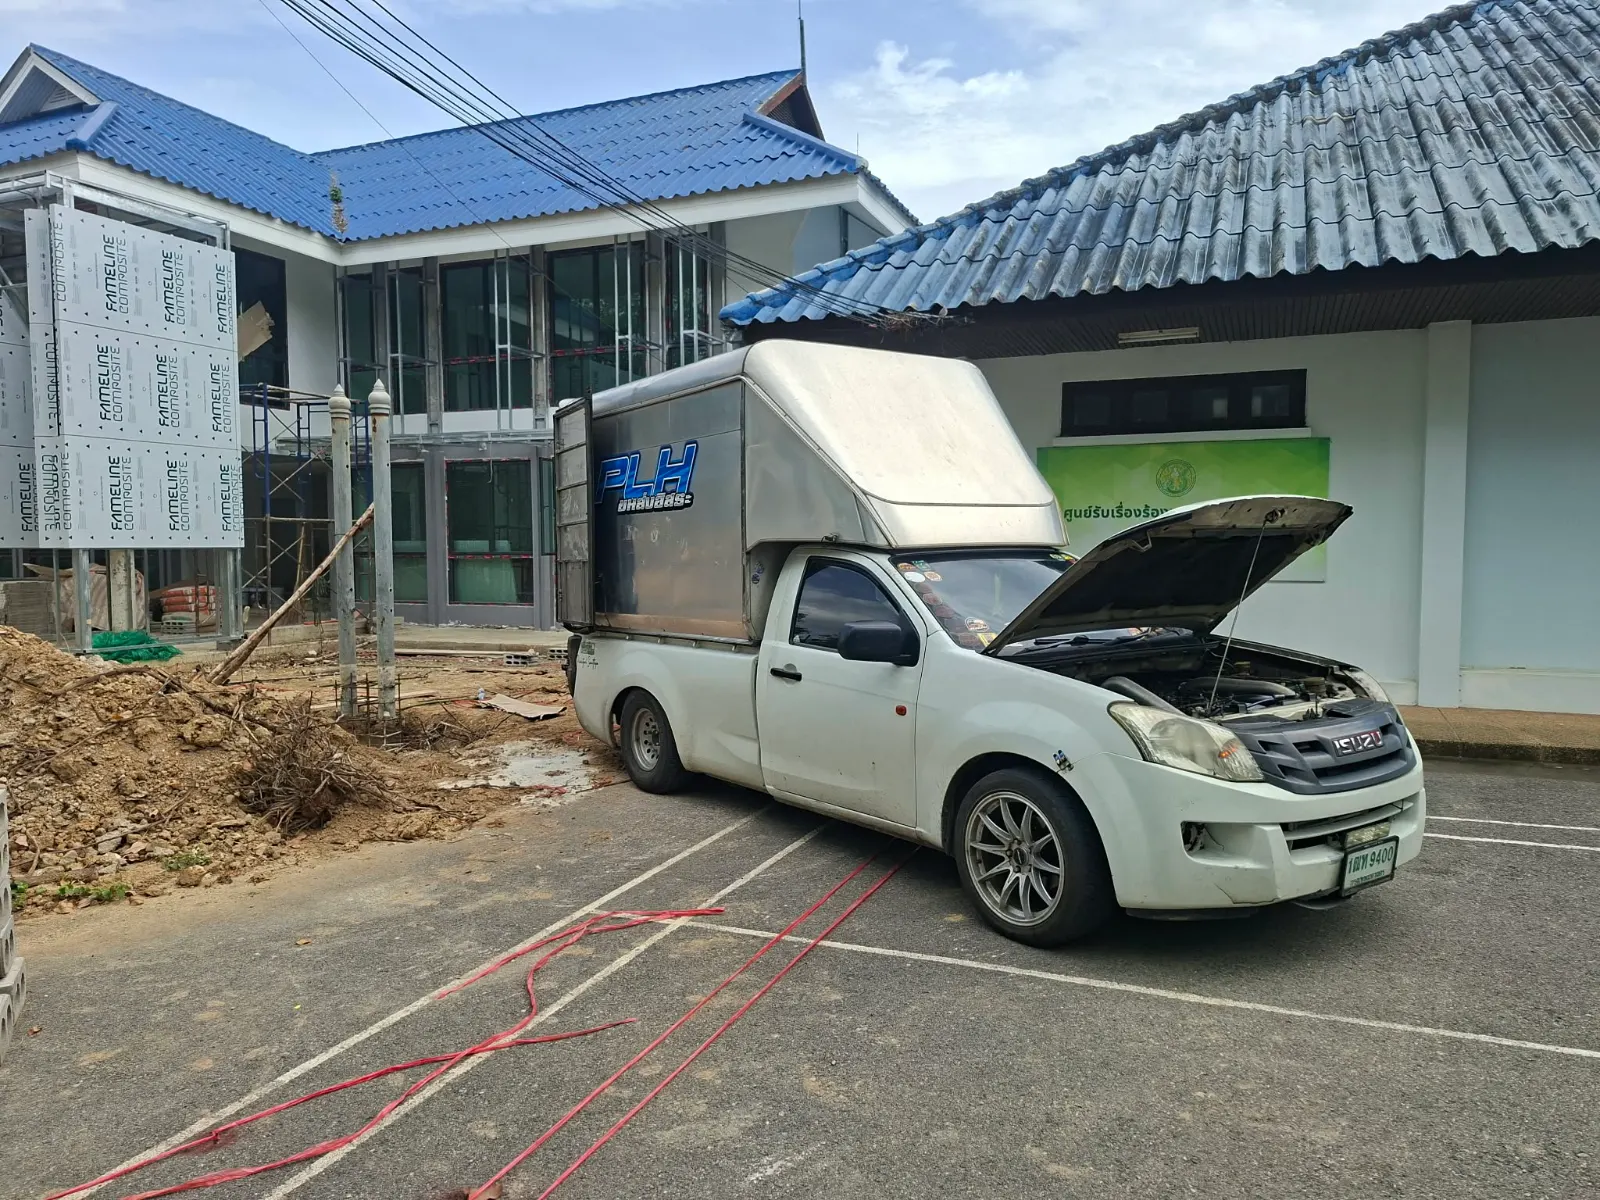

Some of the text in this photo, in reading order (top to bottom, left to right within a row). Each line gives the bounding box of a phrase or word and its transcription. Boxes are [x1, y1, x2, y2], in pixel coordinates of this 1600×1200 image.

[53, 222, 66, 302] COMPOSITE
[103, 234, 117, 312] FAMELINE
[116, 236, 129, 314] COMPOSITE
[162, 249, 175, 323] FAMELINE
[174, 251, 185, 325] COMPOSITE
[215, 263, 228, 333] FAMELINE
[97, 344, 111, 421] FAMELINE
[110, 346, 123, 422] COMPOSITE
[156, 354, 169, 427] FAMELINE
[168, 356, 180, 428] COMPOSITE
[210, 362, 222, 433] FAMELINE
[221, 363, 232, 434] COMPOSITE
[19, 463, 33, 532] FAMELINE
[61, 452, 72, 530] COMPOSITE
[108, 455, 122, 531] FAMELINE
[122, 456, 134, 531] COMPOSITE
[166, 460, 180, 531] FAMELINE
[179, 460, 190, 531] COMPOSITE
[220, 464, 232, 532] FAMELINE
[593, 440, 699, 504] PLH
[1333, 731, 1383, 754] ISUZU
[1370, 846, 1394, 868] 9400
